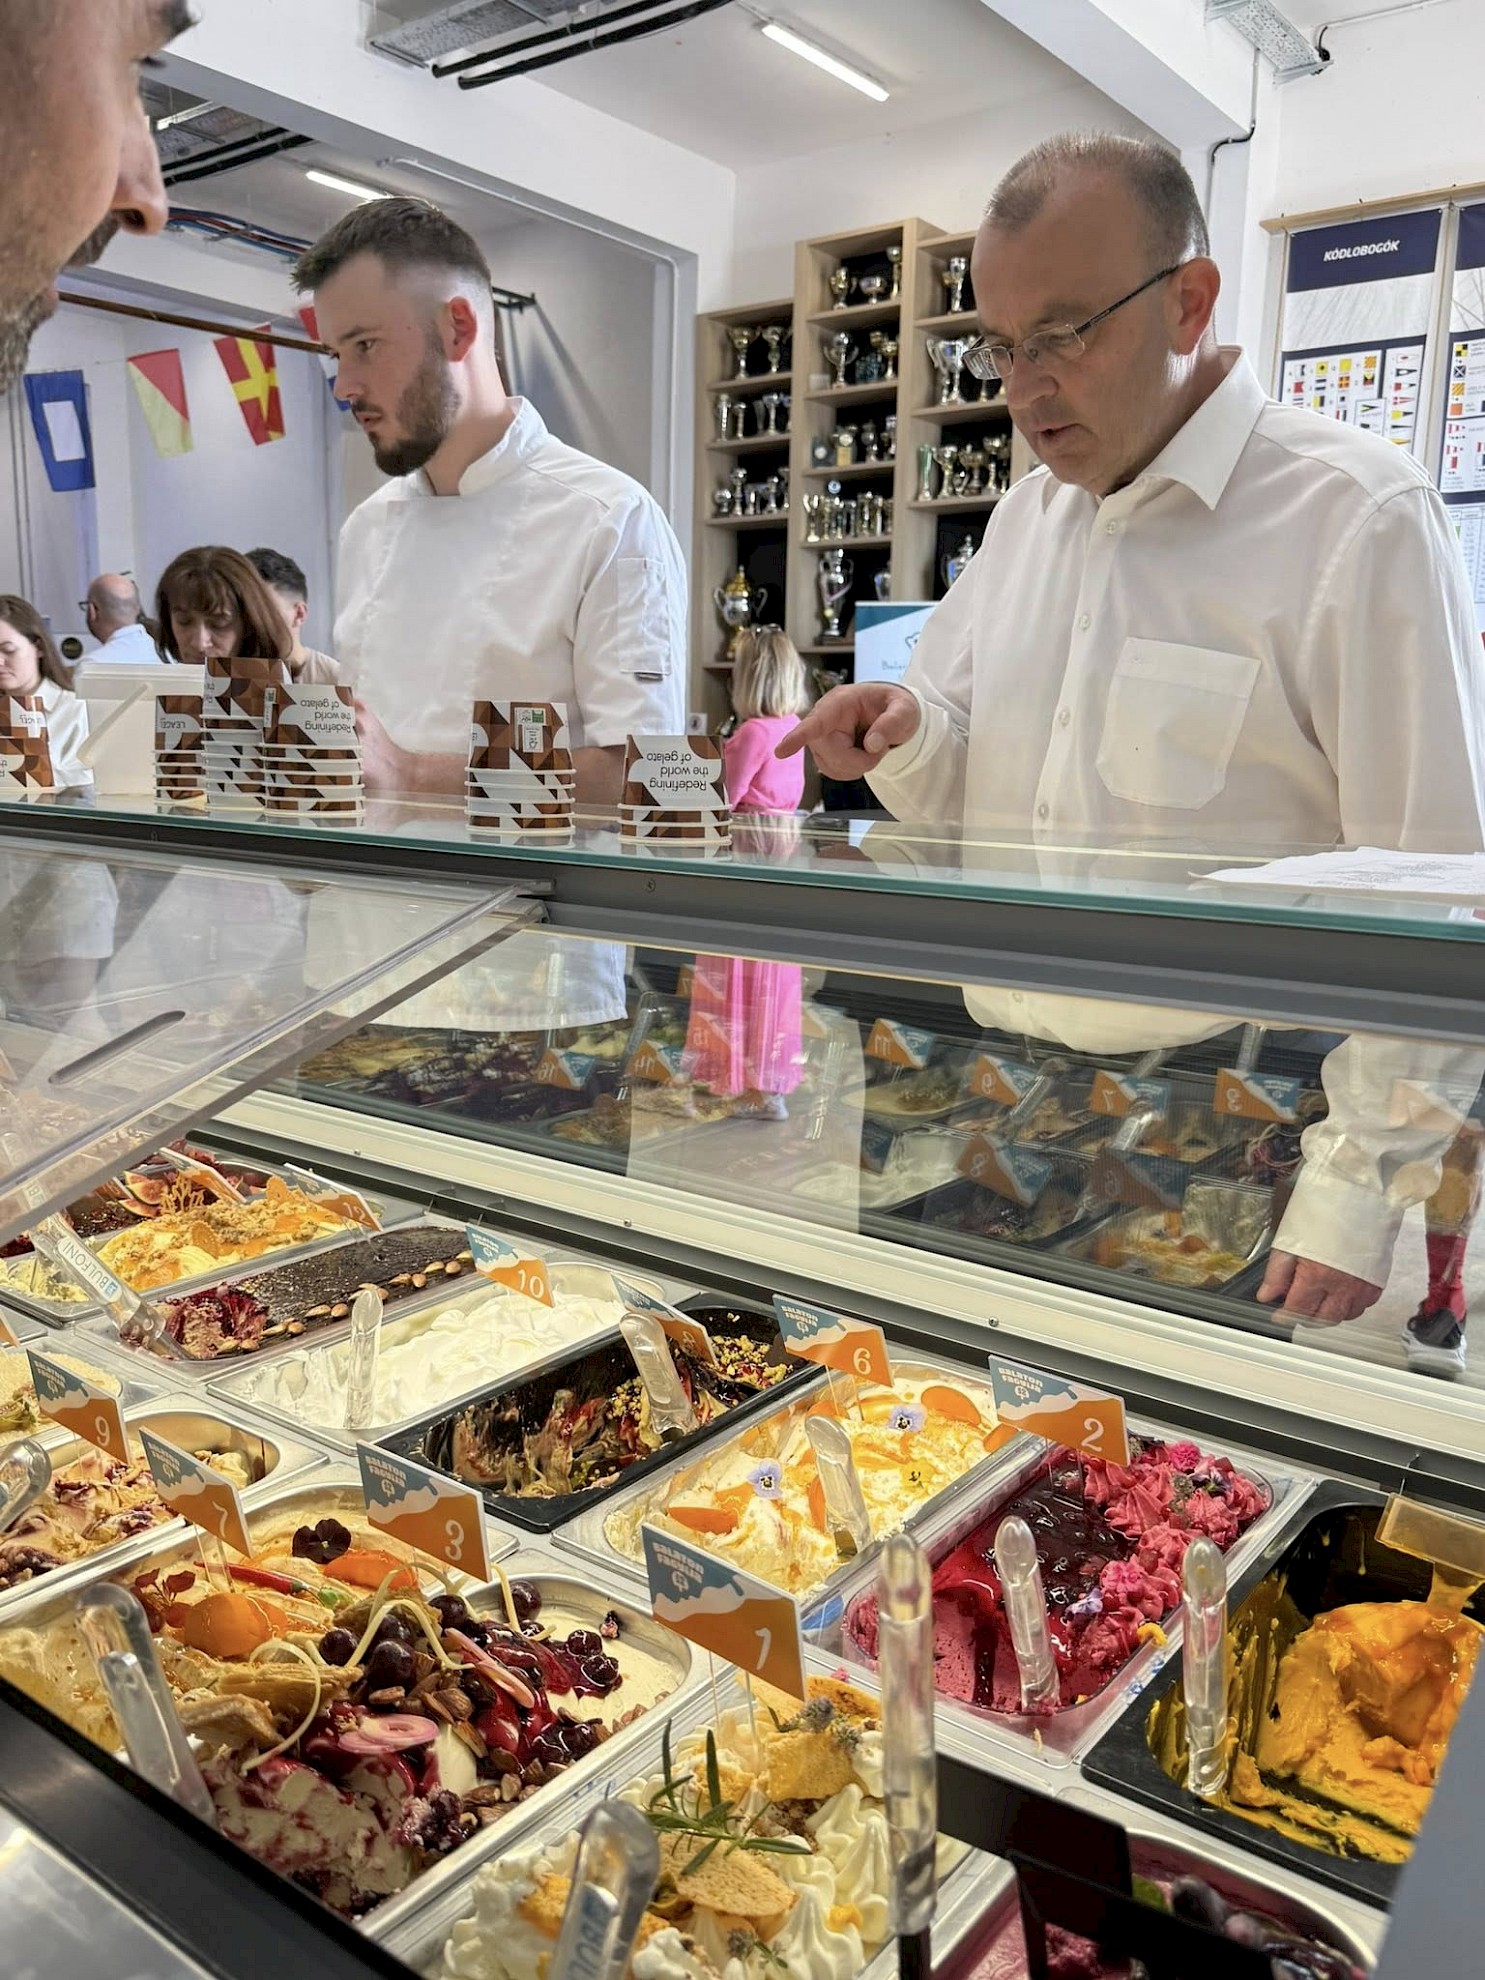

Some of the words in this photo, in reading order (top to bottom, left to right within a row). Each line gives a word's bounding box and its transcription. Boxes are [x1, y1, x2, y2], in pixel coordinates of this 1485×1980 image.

[1323, 239, 1400, 262] KÓDLOBOGÓK
[300, 698, 330, 710] gelato
[331, 701, 340, 710] of
[304, 720, 351, 733] Redefining
[314, 711, 339, 721] world
[646, 750, 679, 764] gelato
[680, 753, 692, 764] of
[660, 766, 691, 778] world
[692, 766, 709, 777] the
[649, 777, 707, 791] Redefining
[342, 1201, 372, 1226] 12
[62, 1240, 108, 1287] BULFONI
[518, 1269, 545, 1299] 10
[852, 1347, 872, 1376] 6
[95, 1415, 111, 1447] 9
[1080, 1417, 1105, 1453] 2
[211, 1500, 228, 1538] 7
[444, 1519, 465, 1561] 3
[754, 1627, 772, 1671] 1
